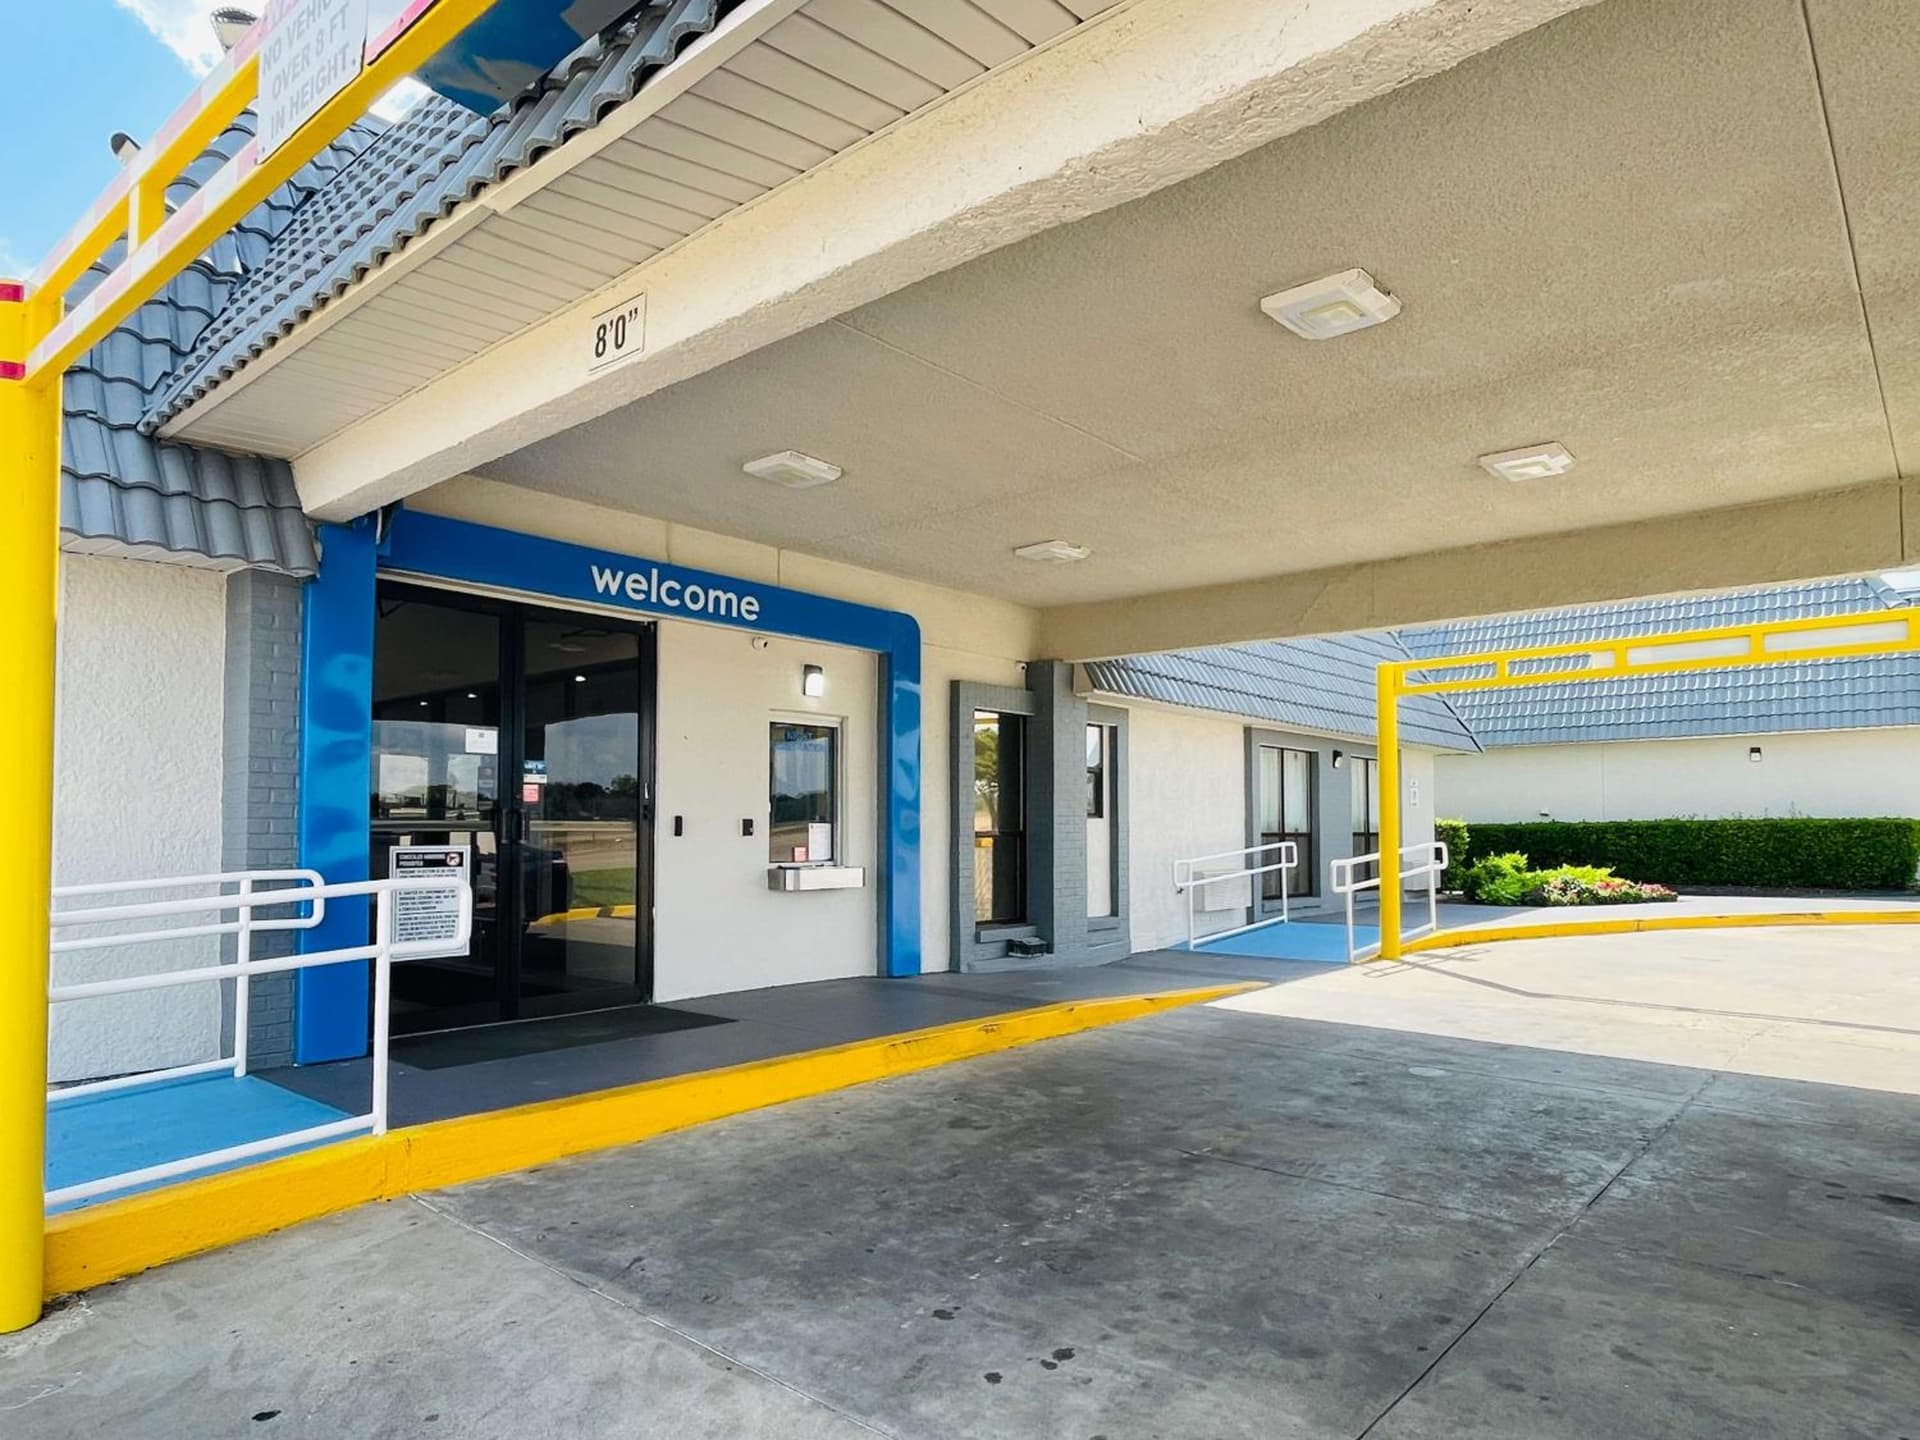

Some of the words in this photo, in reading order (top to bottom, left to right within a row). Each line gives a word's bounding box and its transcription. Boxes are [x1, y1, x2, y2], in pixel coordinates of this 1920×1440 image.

[262, 36, 281, 76] NO
[272, 42, 309, 99] OVER
[316, 28, 324, 57] 8
[329, 0, 349, 44] FT
[271, 105, 285, 140] IN
[591, 564, 760, 621] welcome
